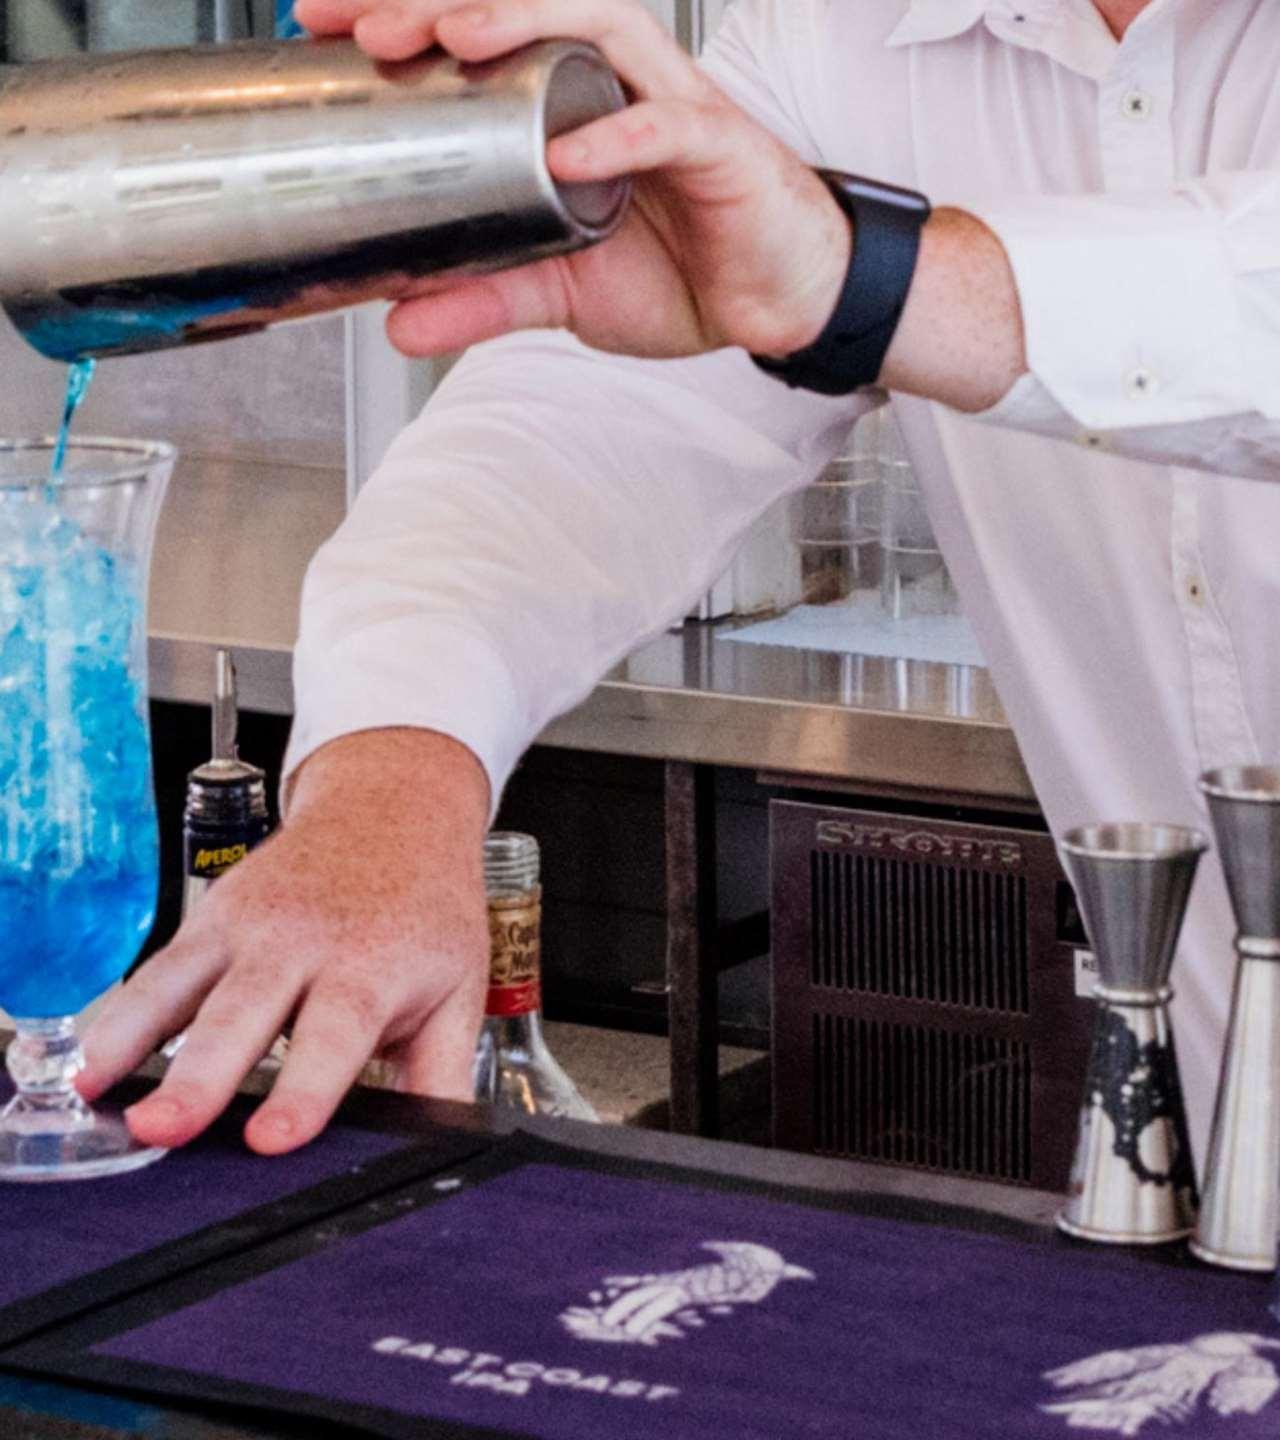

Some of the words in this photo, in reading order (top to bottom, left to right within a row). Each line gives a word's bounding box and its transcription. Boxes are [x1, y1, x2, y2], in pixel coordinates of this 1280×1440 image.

[195, 842, 247, 870] APEROL
[372, 1336, 503, 1369] EAST
[504, 1360, 682, 1401] COAST
[449, 1369, 531, 1397] IPA
